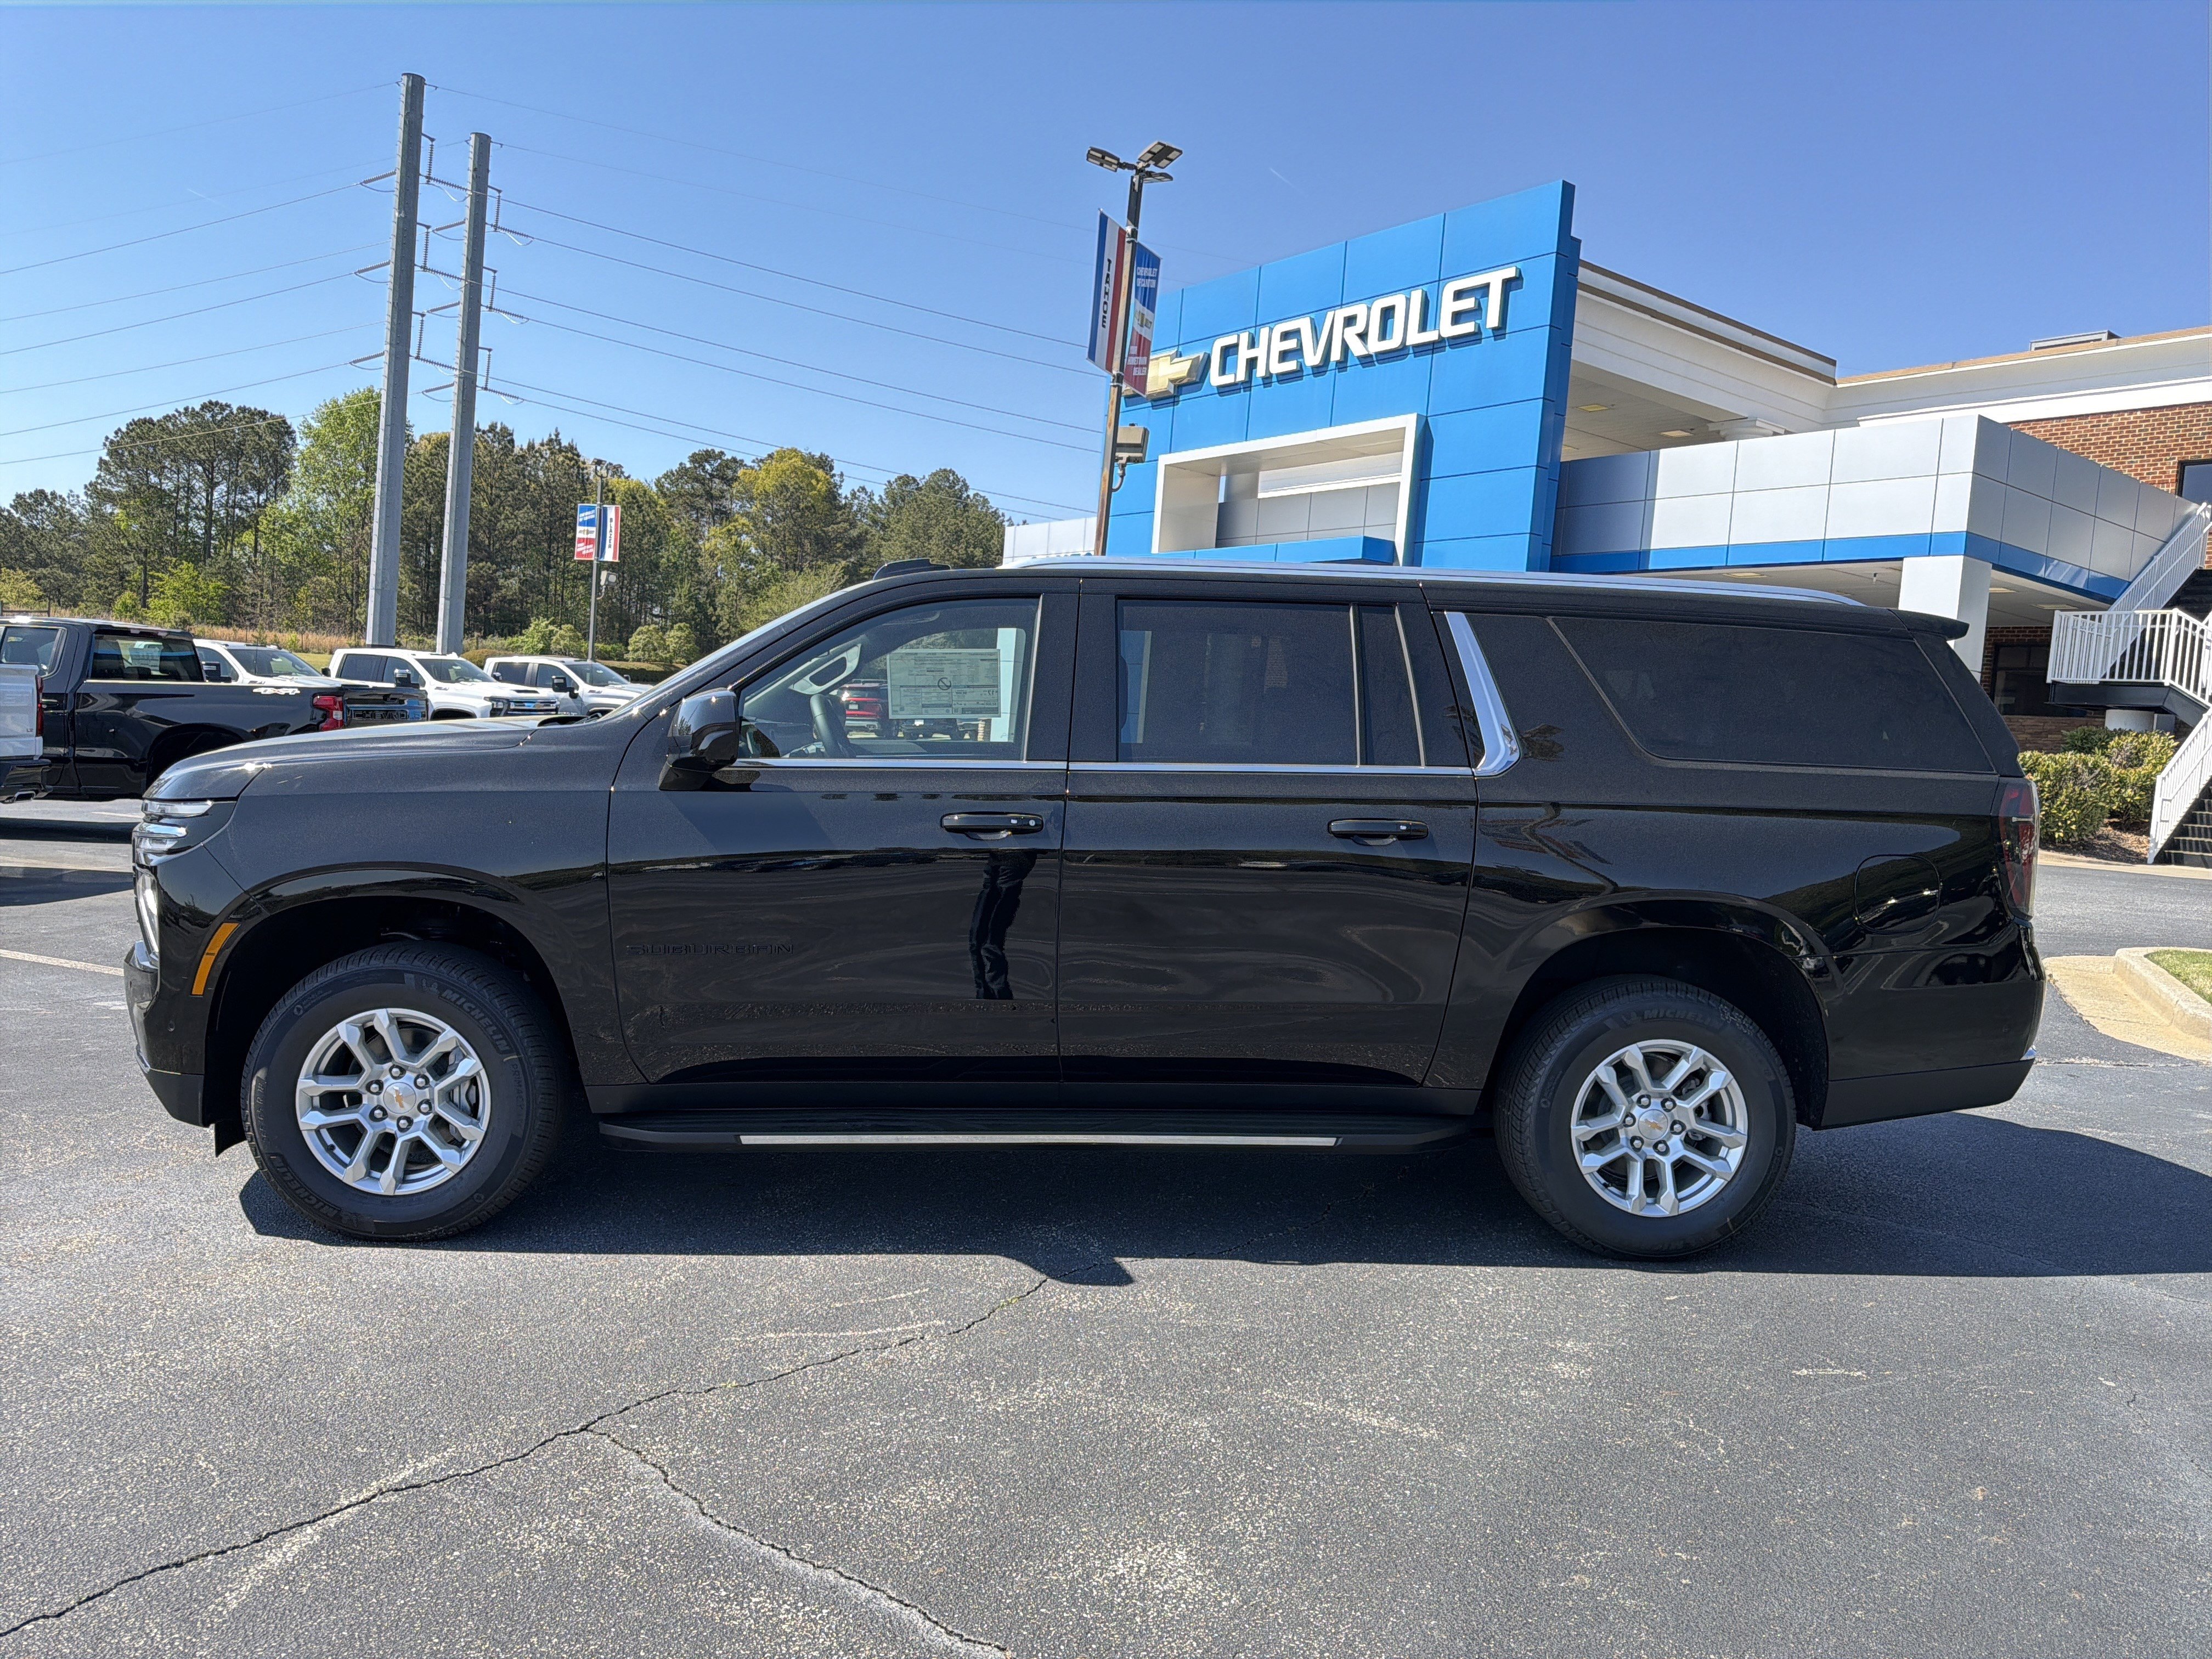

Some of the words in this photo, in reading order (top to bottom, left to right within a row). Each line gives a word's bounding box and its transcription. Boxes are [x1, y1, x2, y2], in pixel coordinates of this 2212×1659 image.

[1102, 258, 1112, 329] TAHOE
[1210, 266, 1520, 387] CHEVROLET
[625, 943, 794, 956] SUBURBAN
[441, 989, 510, 1051] MICHELIN
